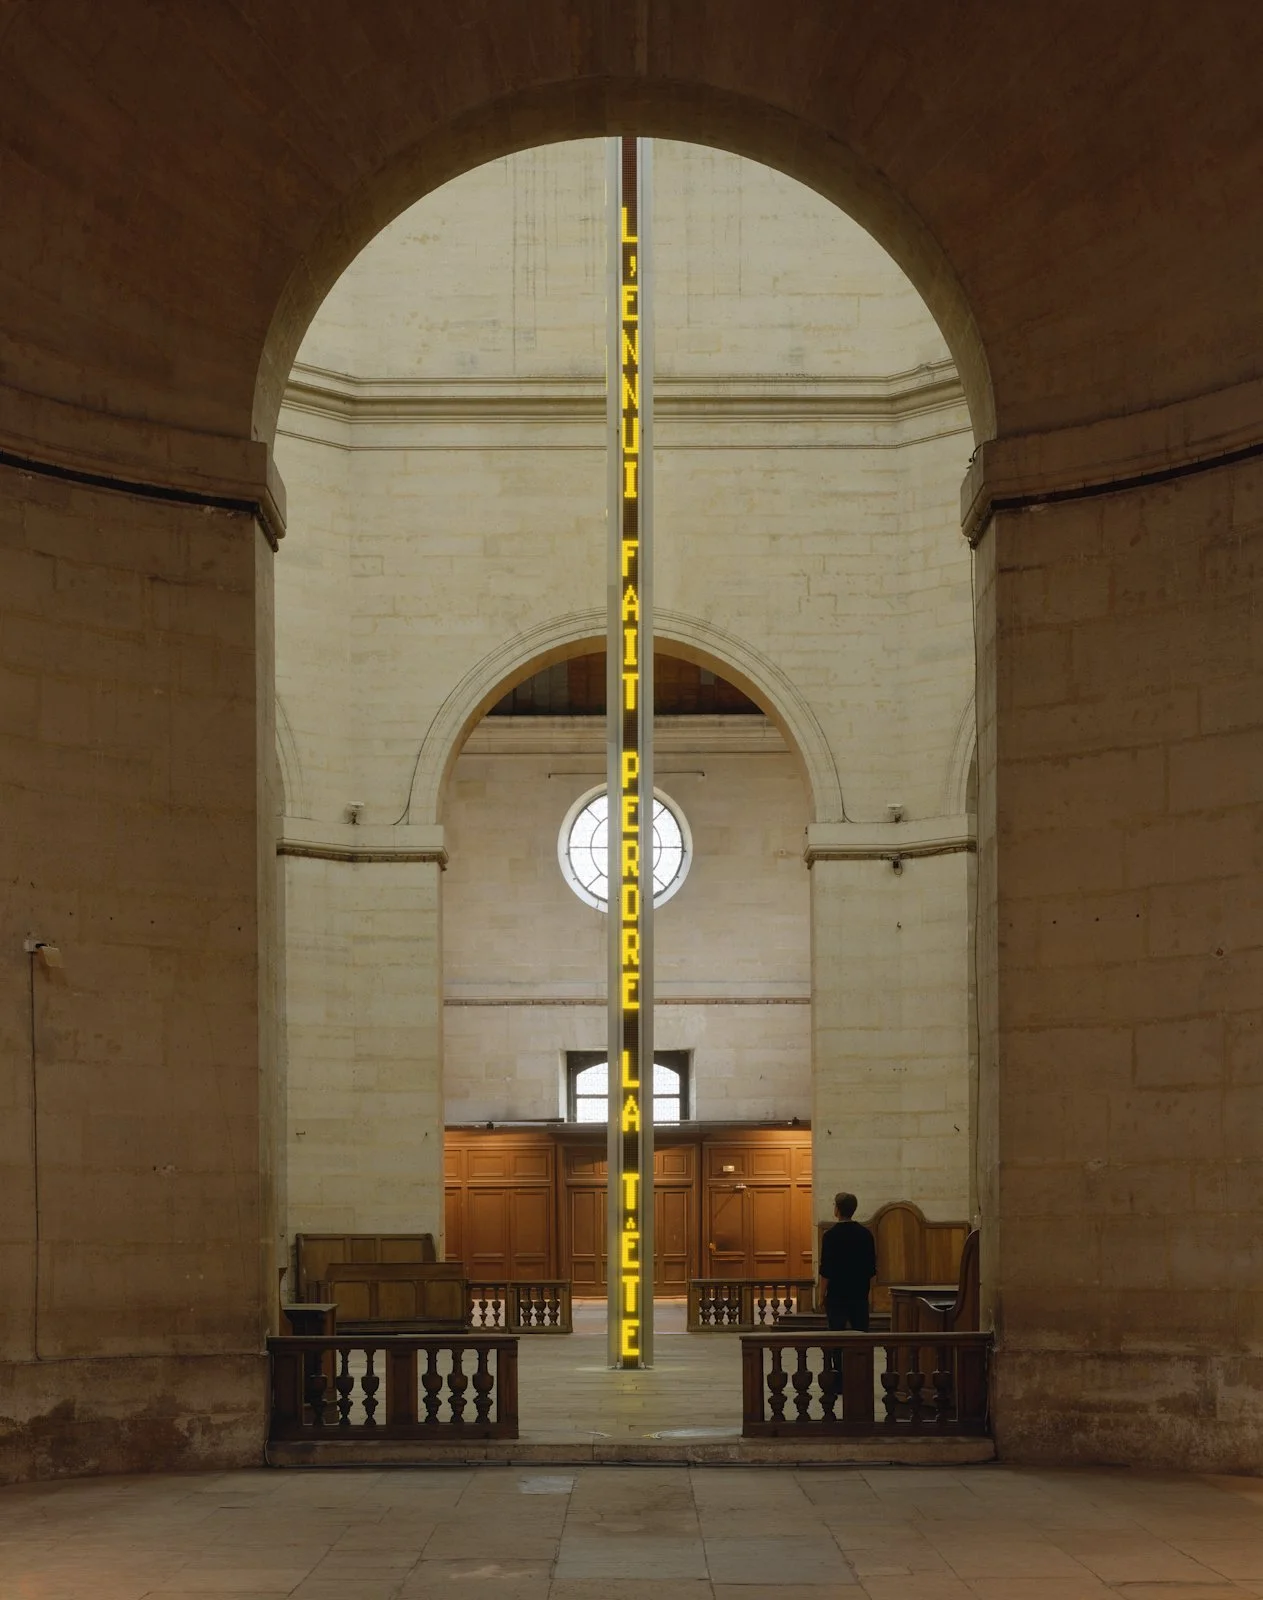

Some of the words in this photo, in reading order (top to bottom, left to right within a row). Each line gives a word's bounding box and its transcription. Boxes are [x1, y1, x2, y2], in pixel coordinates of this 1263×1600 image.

[620, 207, 640, 499] L'ENNUI
[620, 539, 640, 710] FAIT
[620, 751, 640, 1010] PERDRE
[620, 1050, 640, 1132] LA
[620, 1172, 640, 1356] TÊTE
